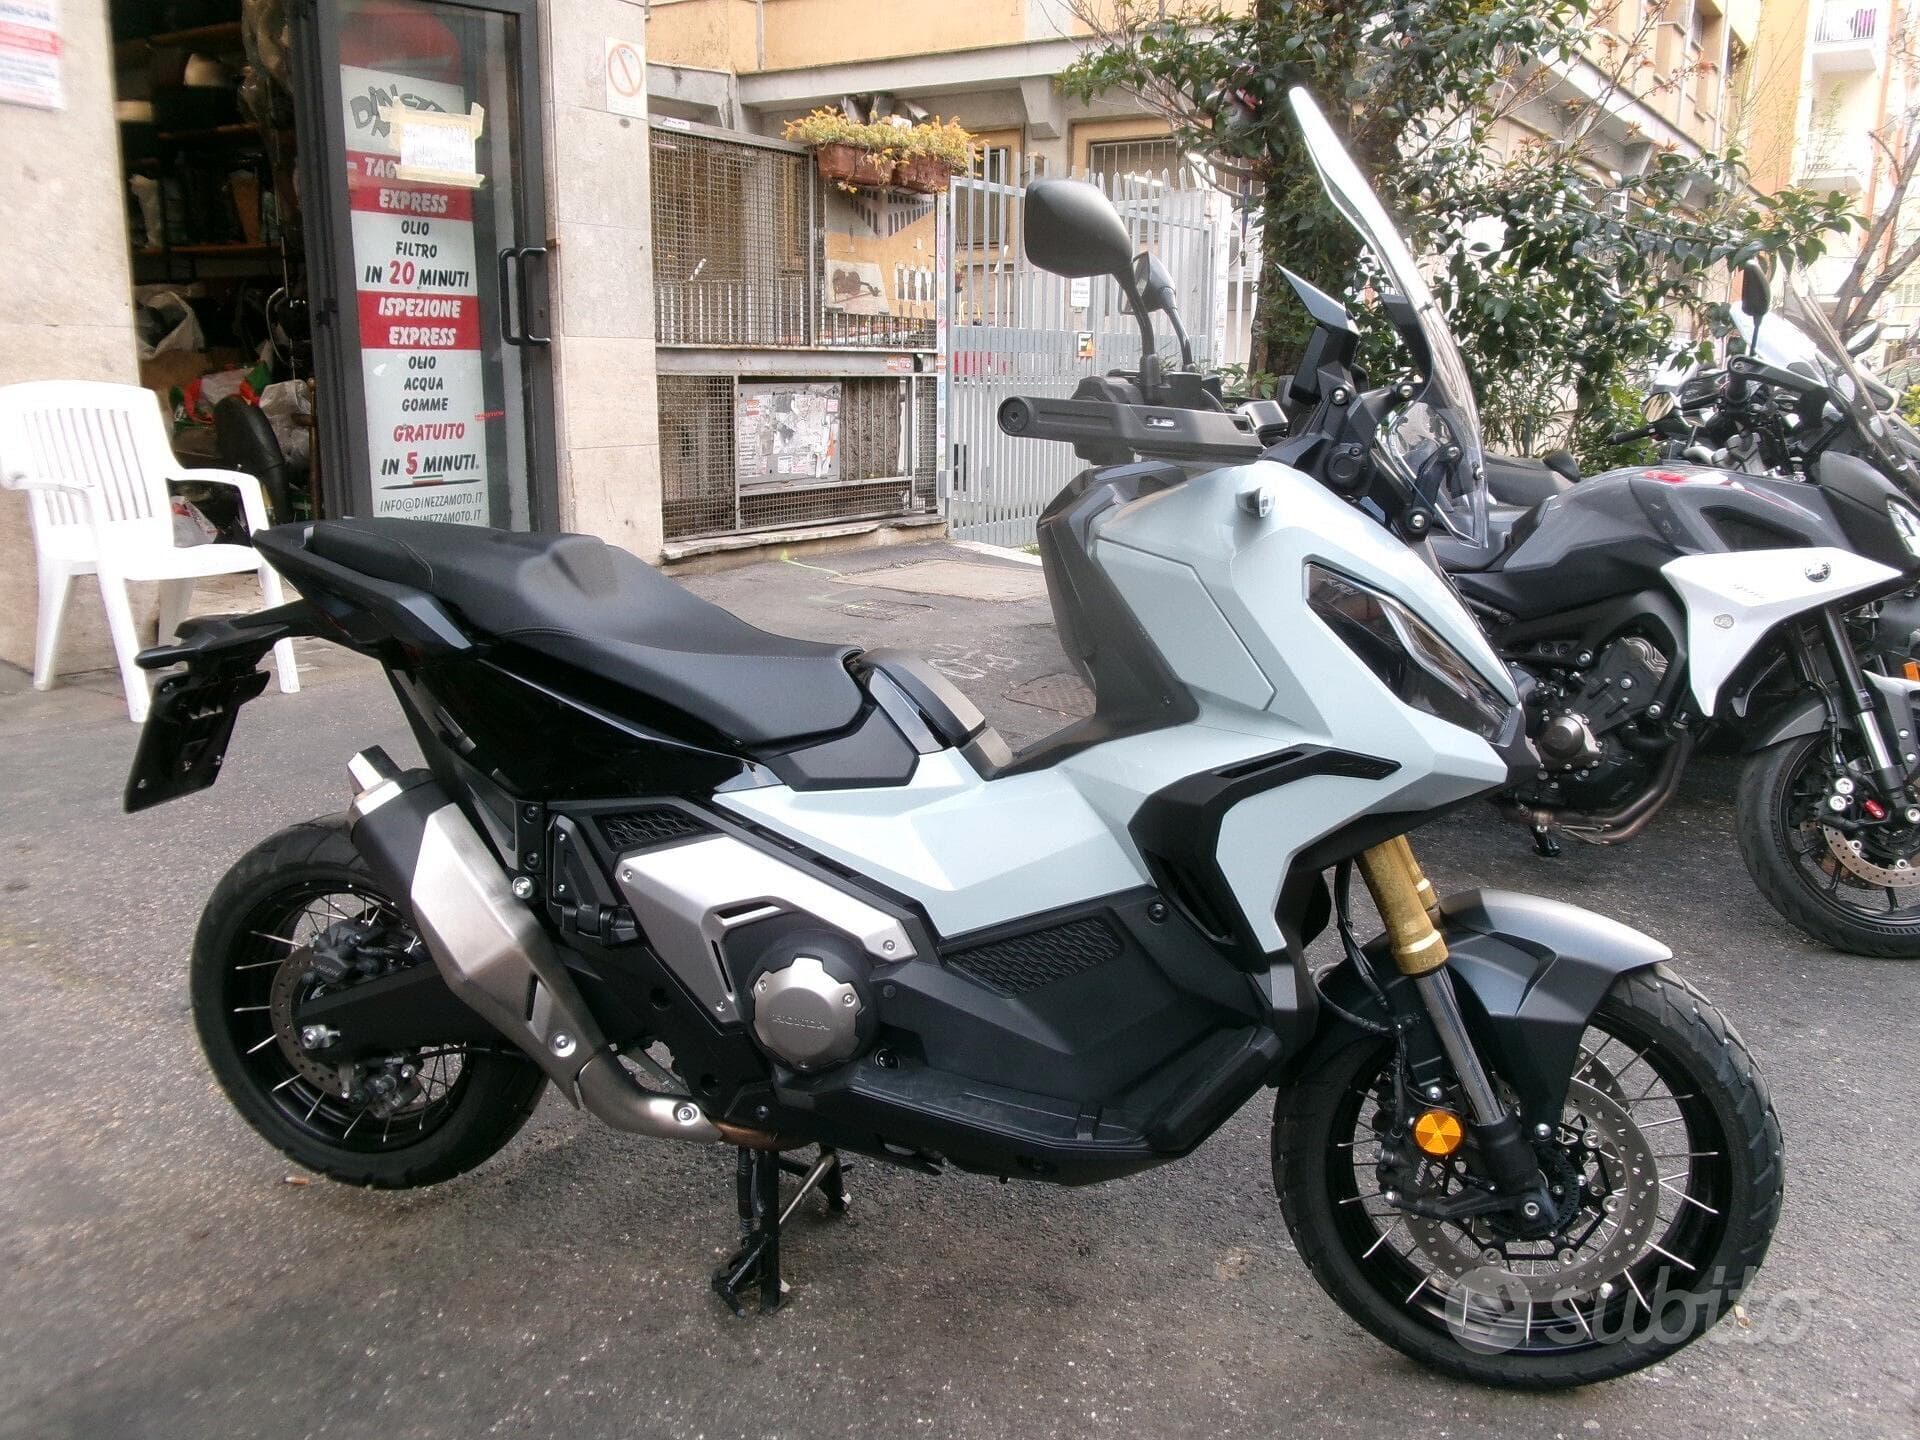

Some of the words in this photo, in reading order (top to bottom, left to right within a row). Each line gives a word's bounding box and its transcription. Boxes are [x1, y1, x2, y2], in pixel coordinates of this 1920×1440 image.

[379, 188, 448, 214] EXPRESS
[401, 219, 430, 236] OLIO
[395, 241, 437, 258] FILTRO
[365, 265, 382, 284] IN
[389, 260, 415, 285] 20
[419, 270, 469, 287] MINUTI
[378, 297, 462, 318] ISPEZIONE
[388, 326, 457, 346] EXPRESS
[408, 355, 436, 370] OLIO
[403, 376, 444, 392] ACQUA
[401, 397, 449, 412] GOMME
[393, 422, 465, 443] GRATUITO
[381, 458, 400, 475] IN
[405, 452, 418, 475] 5
[380, 491, 484, 512] INFO@DINEZZAMOTO.IT
